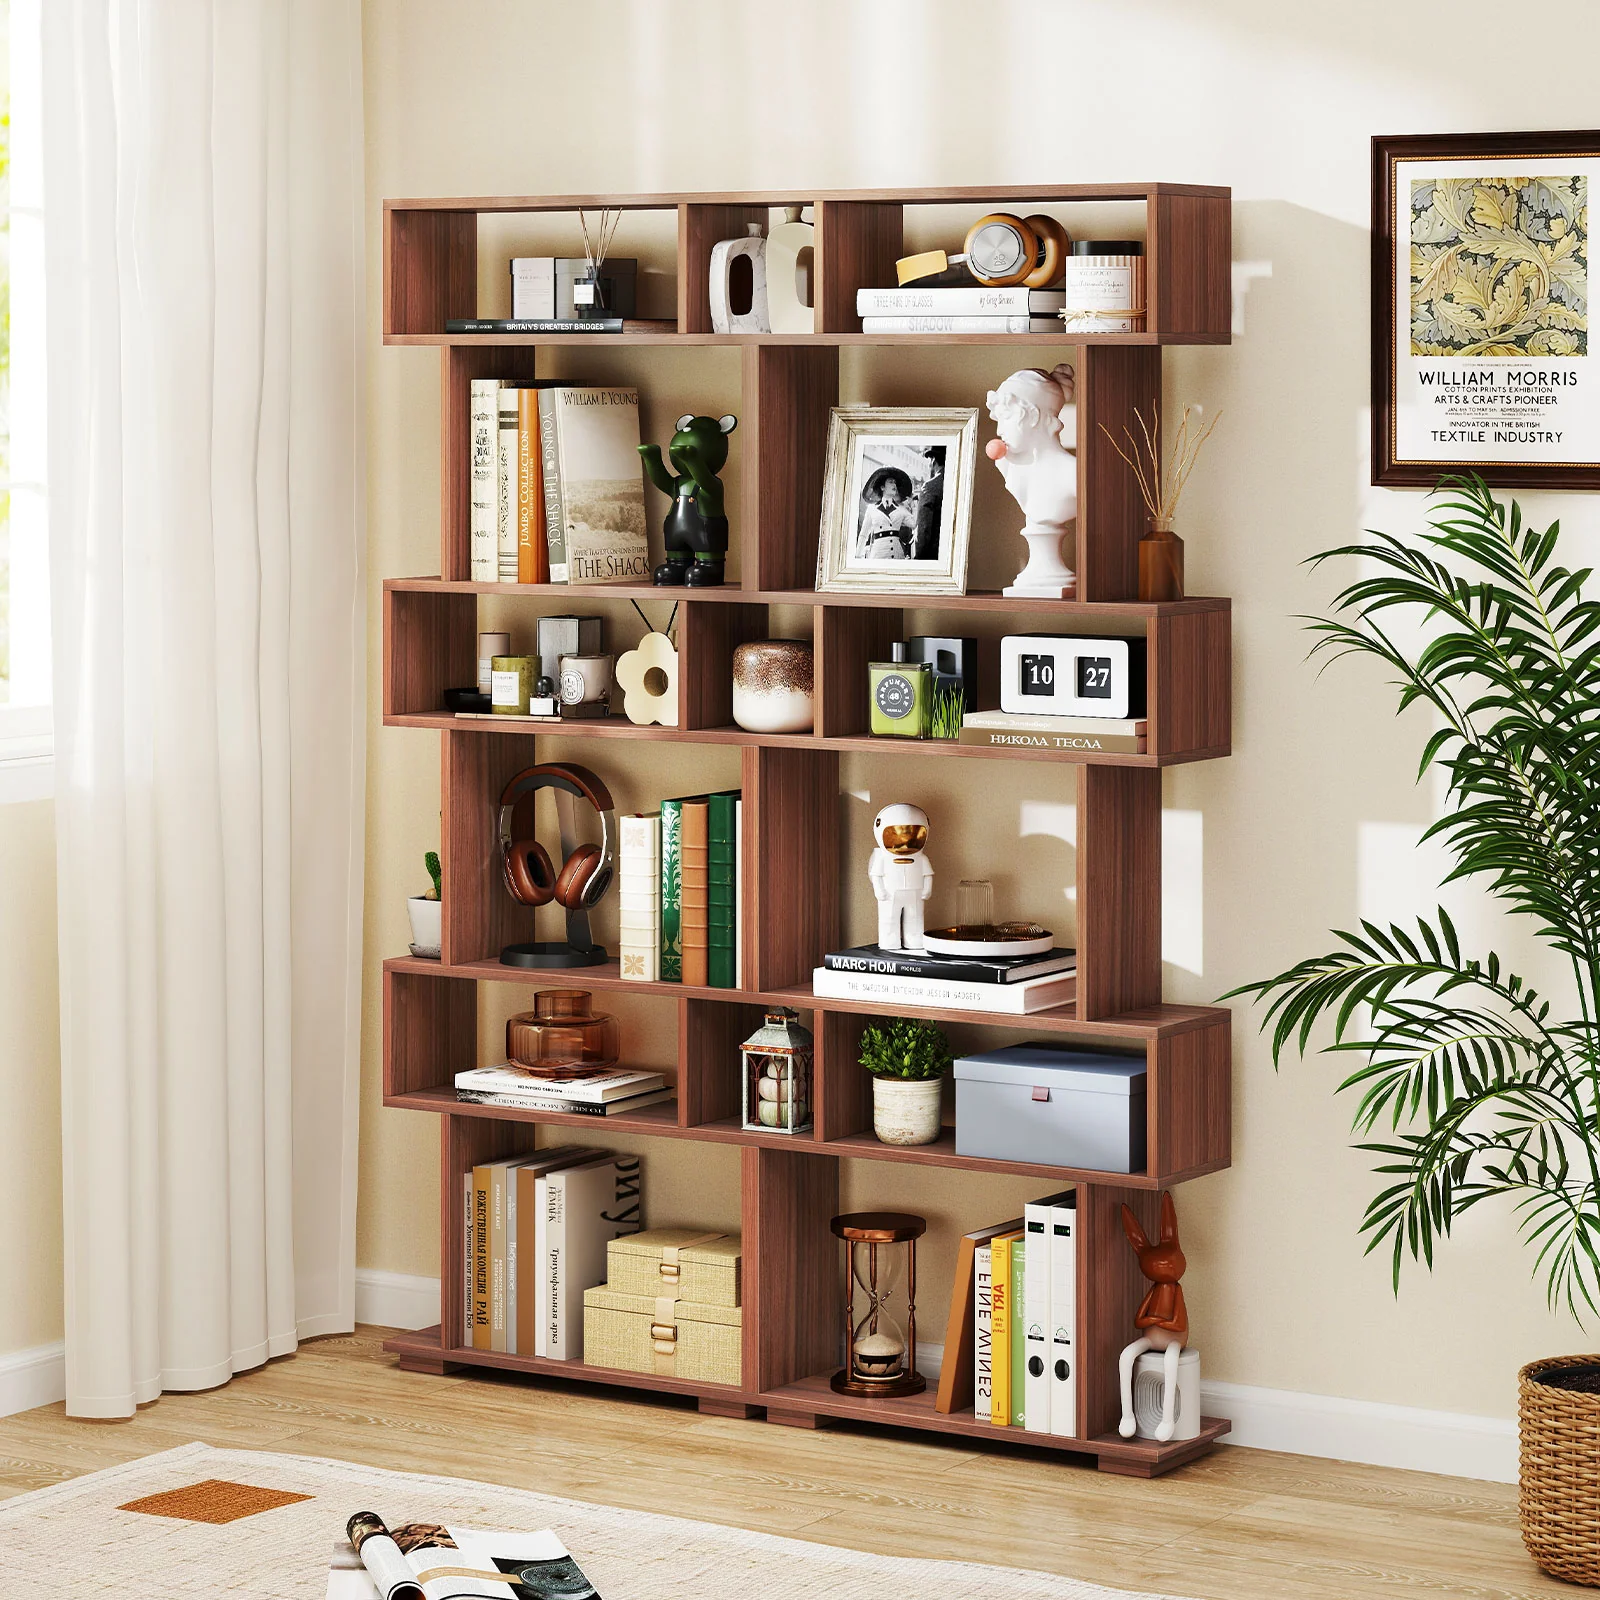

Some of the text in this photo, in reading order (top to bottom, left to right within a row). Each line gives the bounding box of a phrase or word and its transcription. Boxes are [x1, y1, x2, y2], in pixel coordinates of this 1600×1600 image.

[908, 317, 954, 332] SHADOW
[1419, 371, 1578, 386] WILLIAM MORRIS
[564, 392, 598, 406] WILLIAM
[608, 392, 638, 405] YOUNG
[1434, 395, 1558, 404] ARTS & CRAFTS PIONEER
[542, 412, 554, 459] YOUNG
[1431, 431, 1562, 443] TEXTILE INDUSTRY
[520, 430, 532, 547] JUMBO COLLECTION
[544, 472, 562, 547] THE SHACK
[574, 555, 650, 578] THE SHACK
[1030, 664, 1110, 687] 10 27
[890, 692, 900, 700] 48
[990, 734, 1102, 749] НИКОЛА ТЕСЛА
[832, 958, 866, 970] MARC
[868, 961, 896, 974] HOM
[848, 982, 981, 1000] THE SWEDISH INTERIOR DESIGN GADGETS
[494, 1098, 559, 1109] MOCKINGBIRD
[477, 1190, 489, 1326] БОЖЕСТВЕННАЯ КОМЕДИЯ РАЙ
[466, 1276, 471, 1286] по
[550, 1248, 559, 1344] Триумфальная арка
[466, 1313, 474, 1329] Боб
